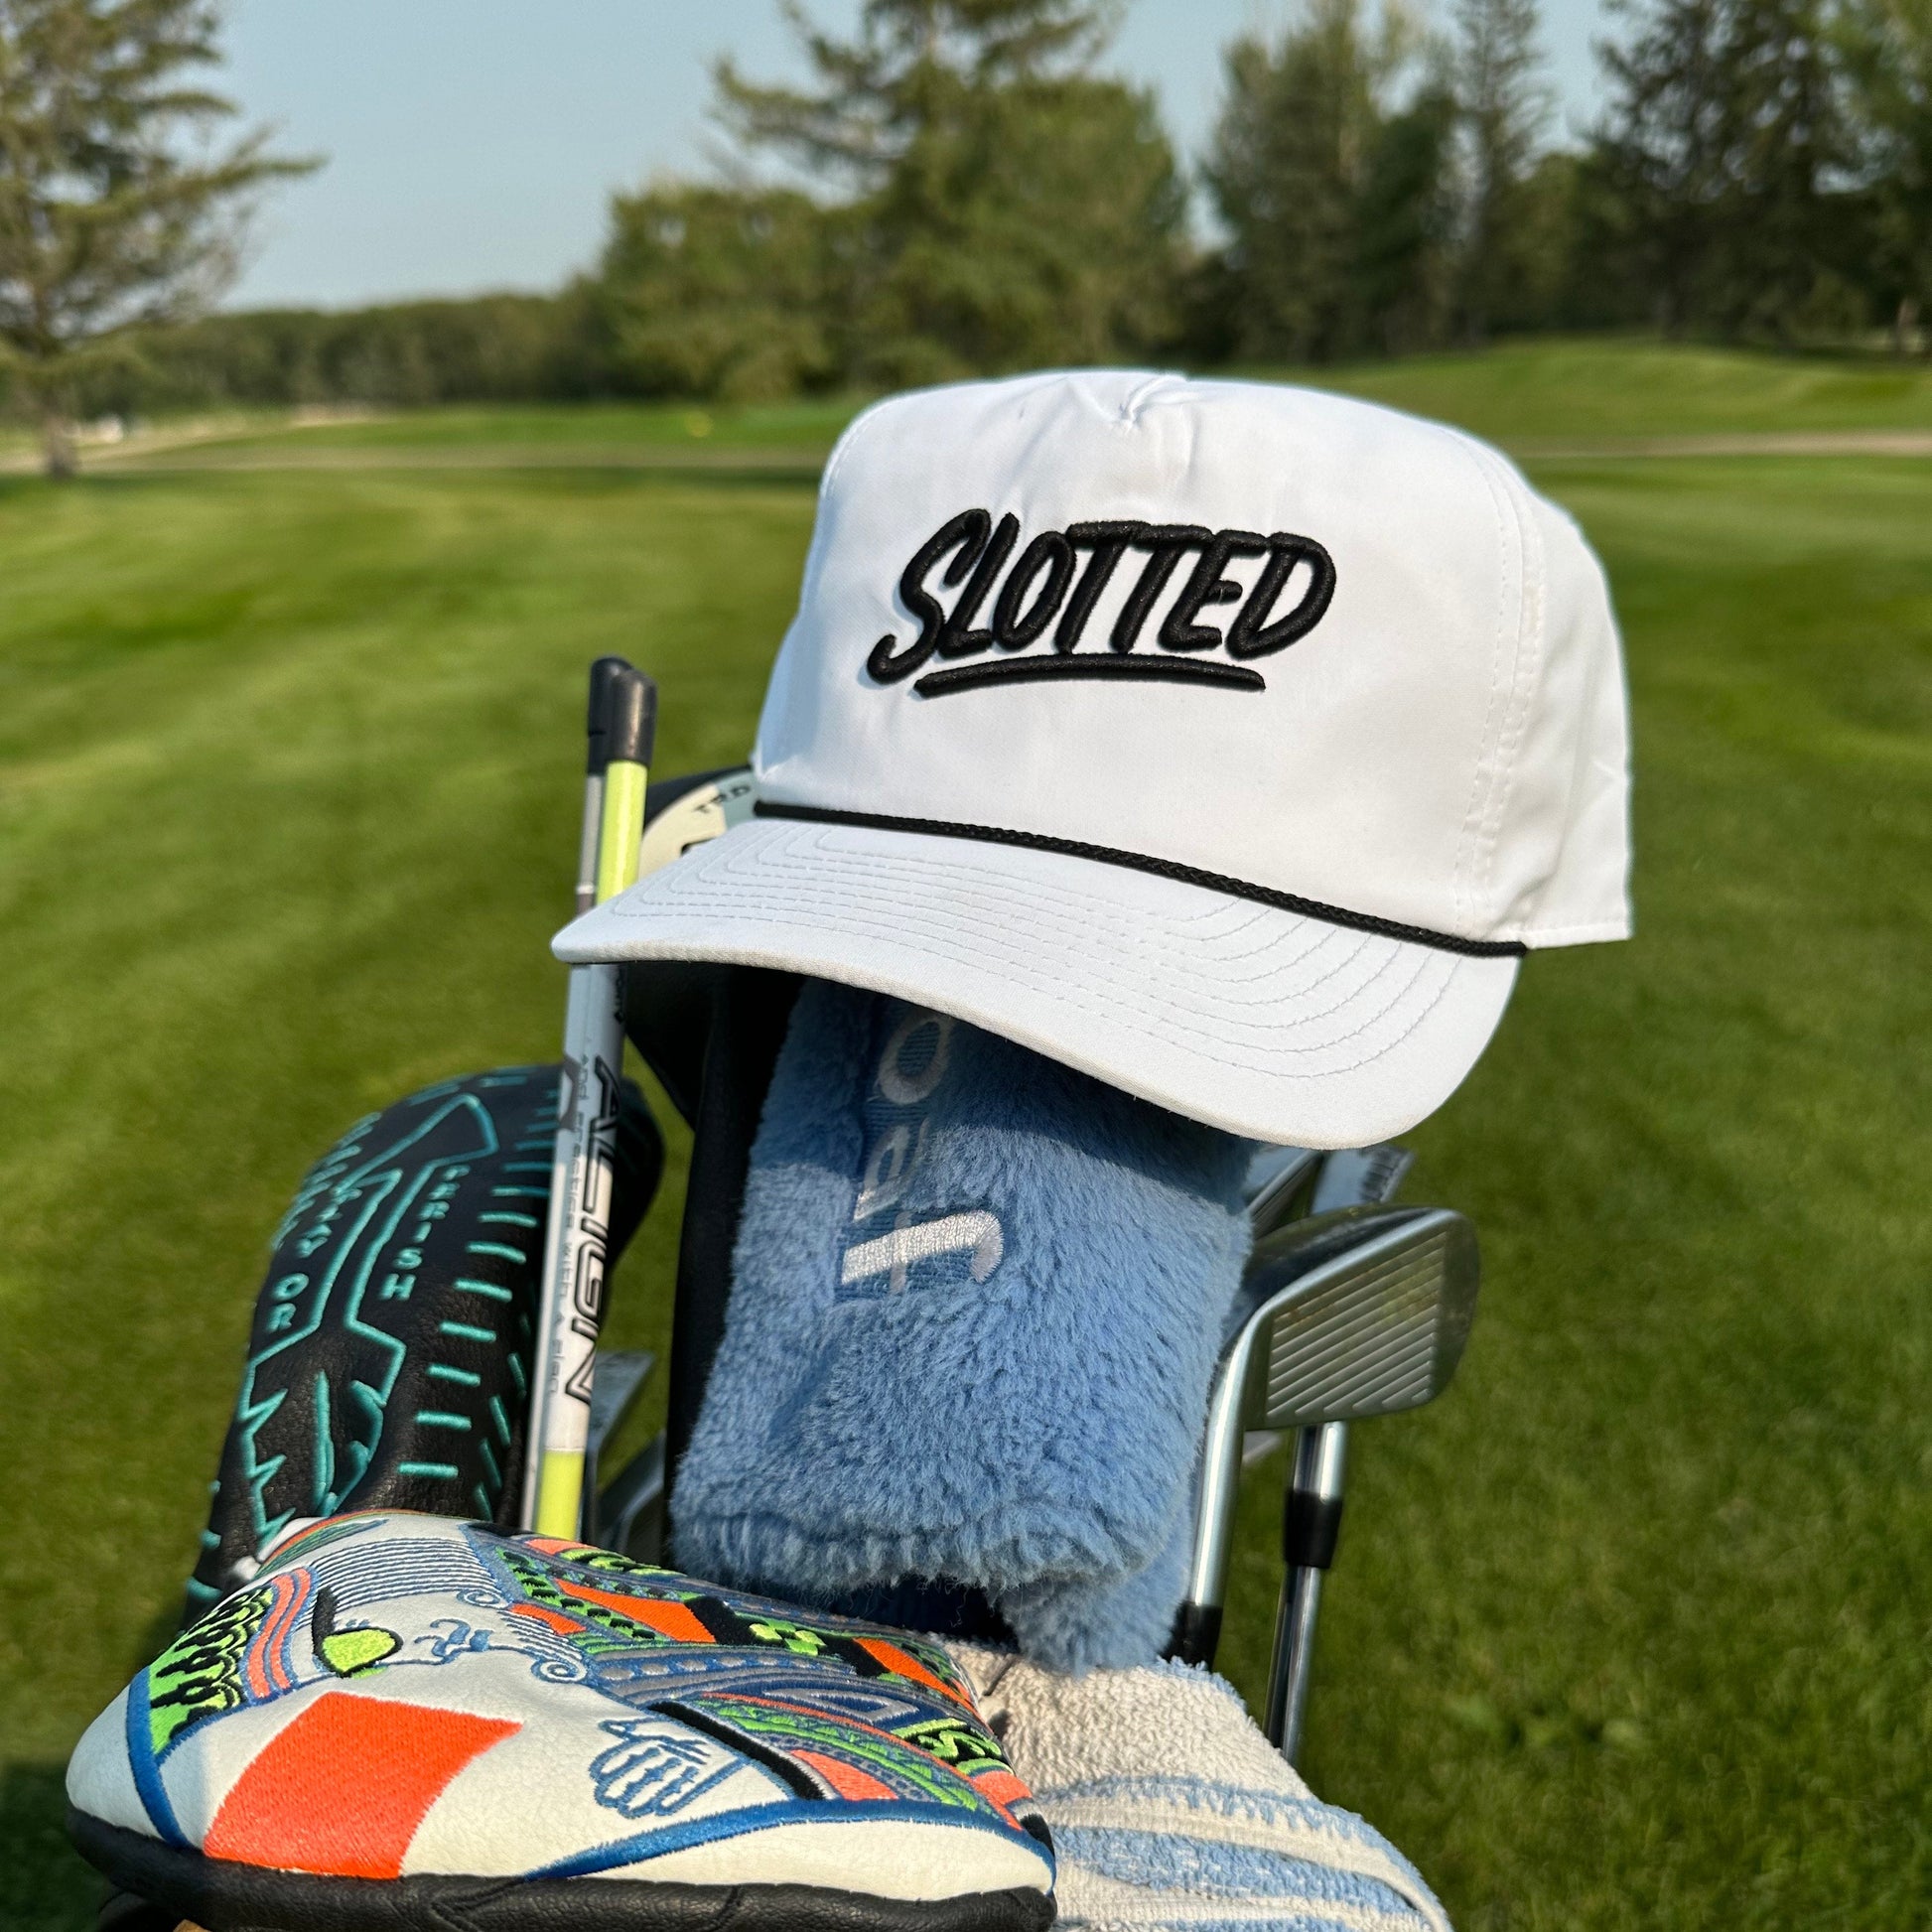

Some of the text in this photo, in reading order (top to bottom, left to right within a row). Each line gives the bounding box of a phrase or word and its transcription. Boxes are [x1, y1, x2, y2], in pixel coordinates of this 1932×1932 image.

[867, 507, 1337, 685] SLOTTED
[265, 1272, 310, 1333] OR
[375, 1165, 472, 1302] PERISH
[564, 1054, 621, 1407] ALIGN
